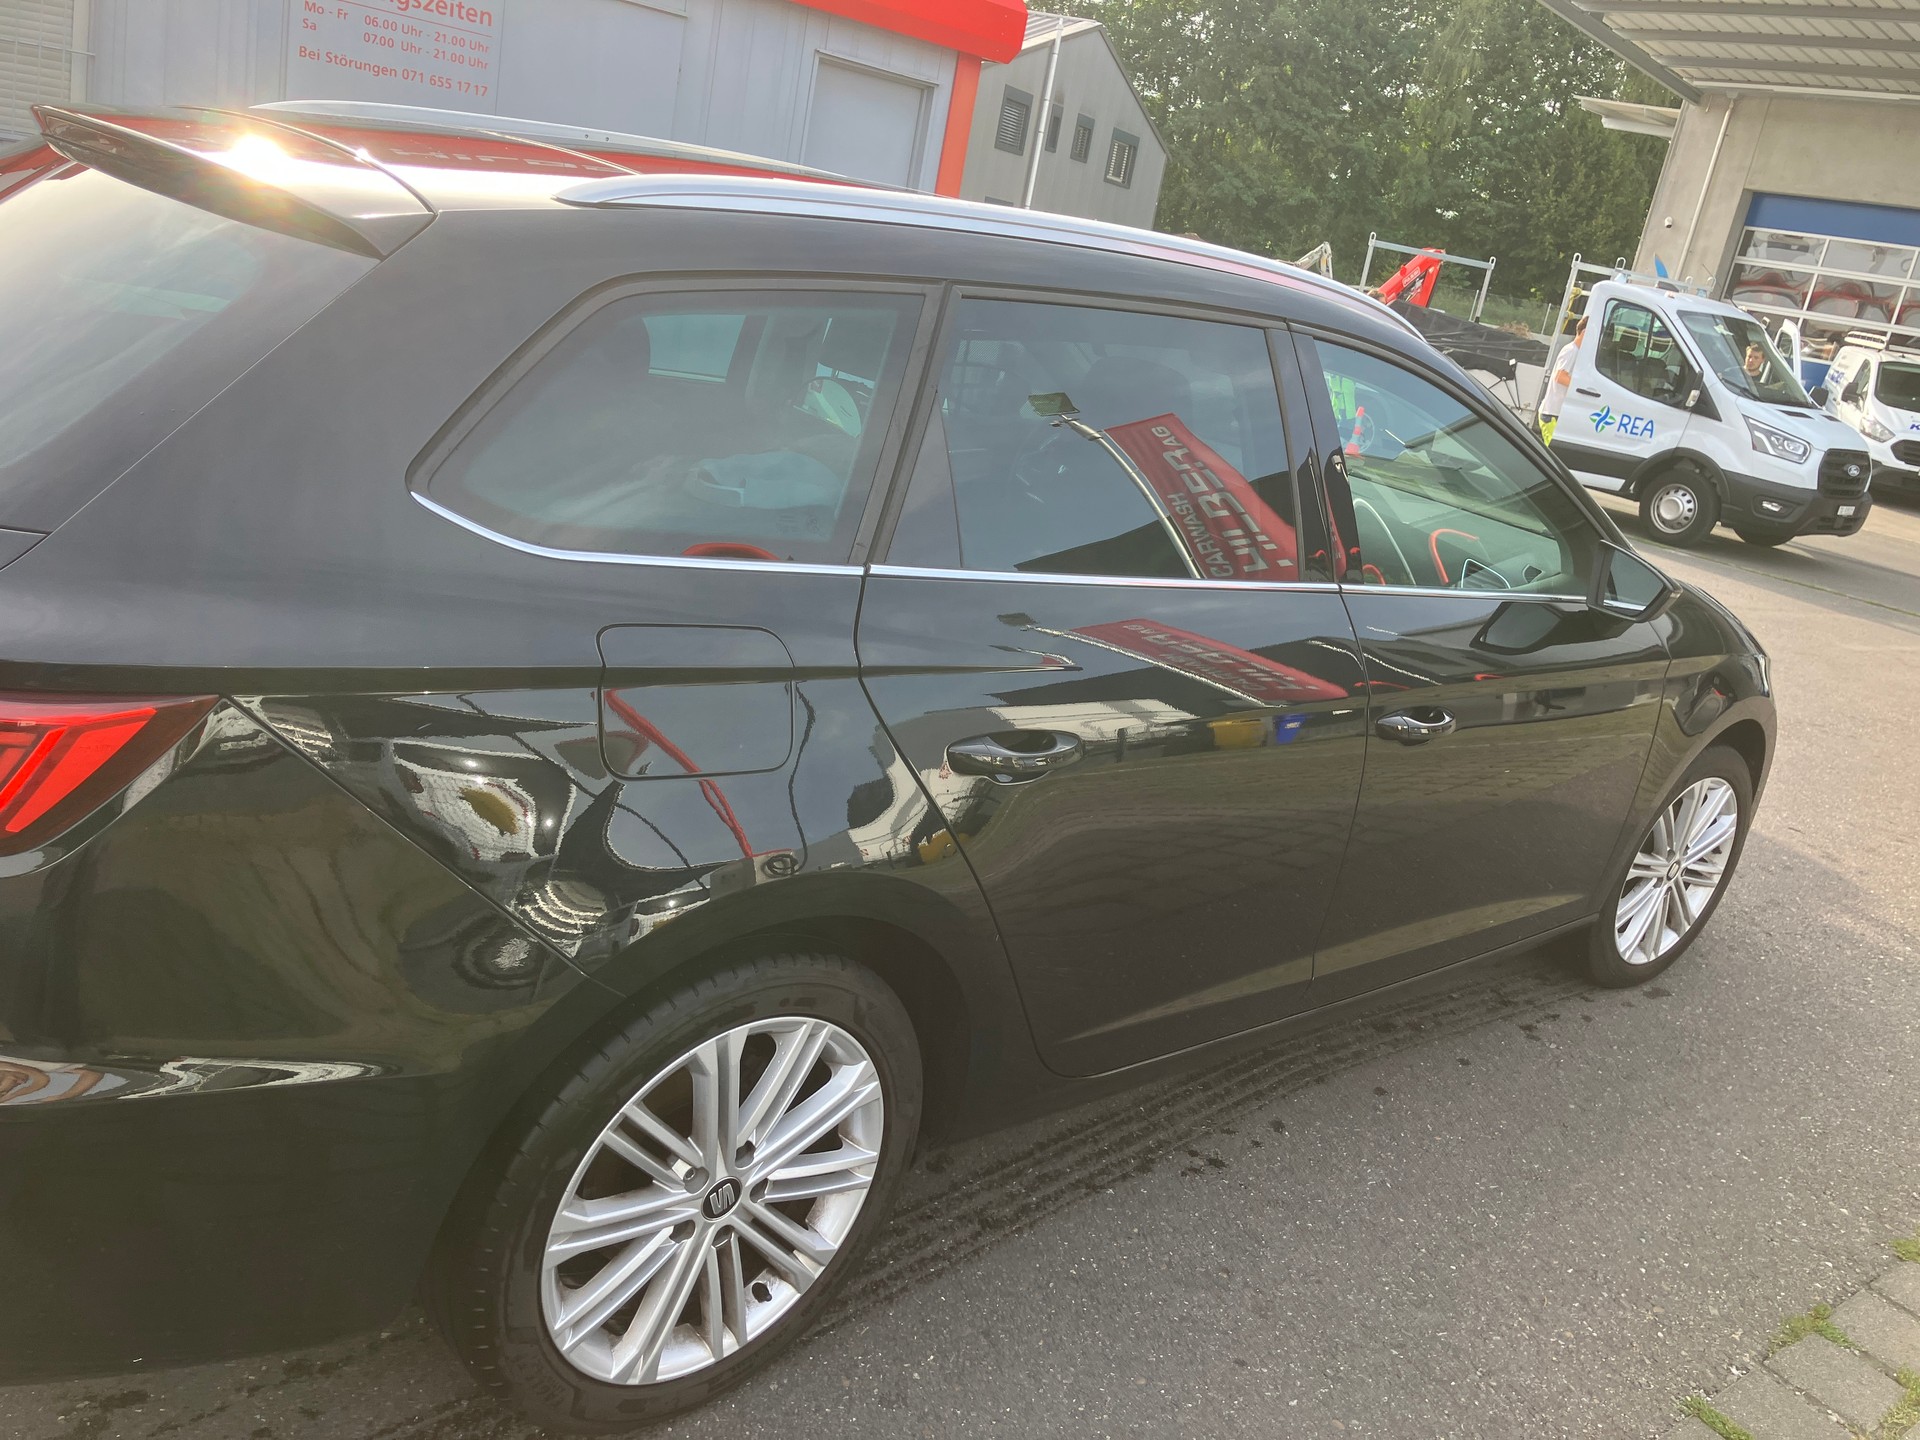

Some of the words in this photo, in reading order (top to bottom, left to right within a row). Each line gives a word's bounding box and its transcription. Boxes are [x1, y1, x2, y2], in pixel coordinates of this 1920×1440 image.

[304, 0, 325, 15] Mo
[337, 8, 349, 20] Fr
[364, 15, 398, 32] 06.00
[401, 23, 423, 38] Uhr
[434, 31, 466, 48] 21.00
[469, 40, 490, 53] Uhr
[389, 0, 493, 27] gszeiten
[299, 45, 320, 61] Bei
[325, 51, 398, 78] Störungen
[401, 68, 424, 83] 071
[429, 74, 452, 90] 655
[302, 18, 317, 31] Sa
[363, 32, 395, 48] 07.00
[400, 40, 422, 55] Uhr
[433, 48, 465, 65] 21.00
[468, 55, 488, 70] Uhr
[1151, 426, 1183, 446] AG
[1617, 414, 1655, 438] REA
[1163, 447, 1294, 573] HILBER
[1166, 492, 1234, 577] CARWASH
